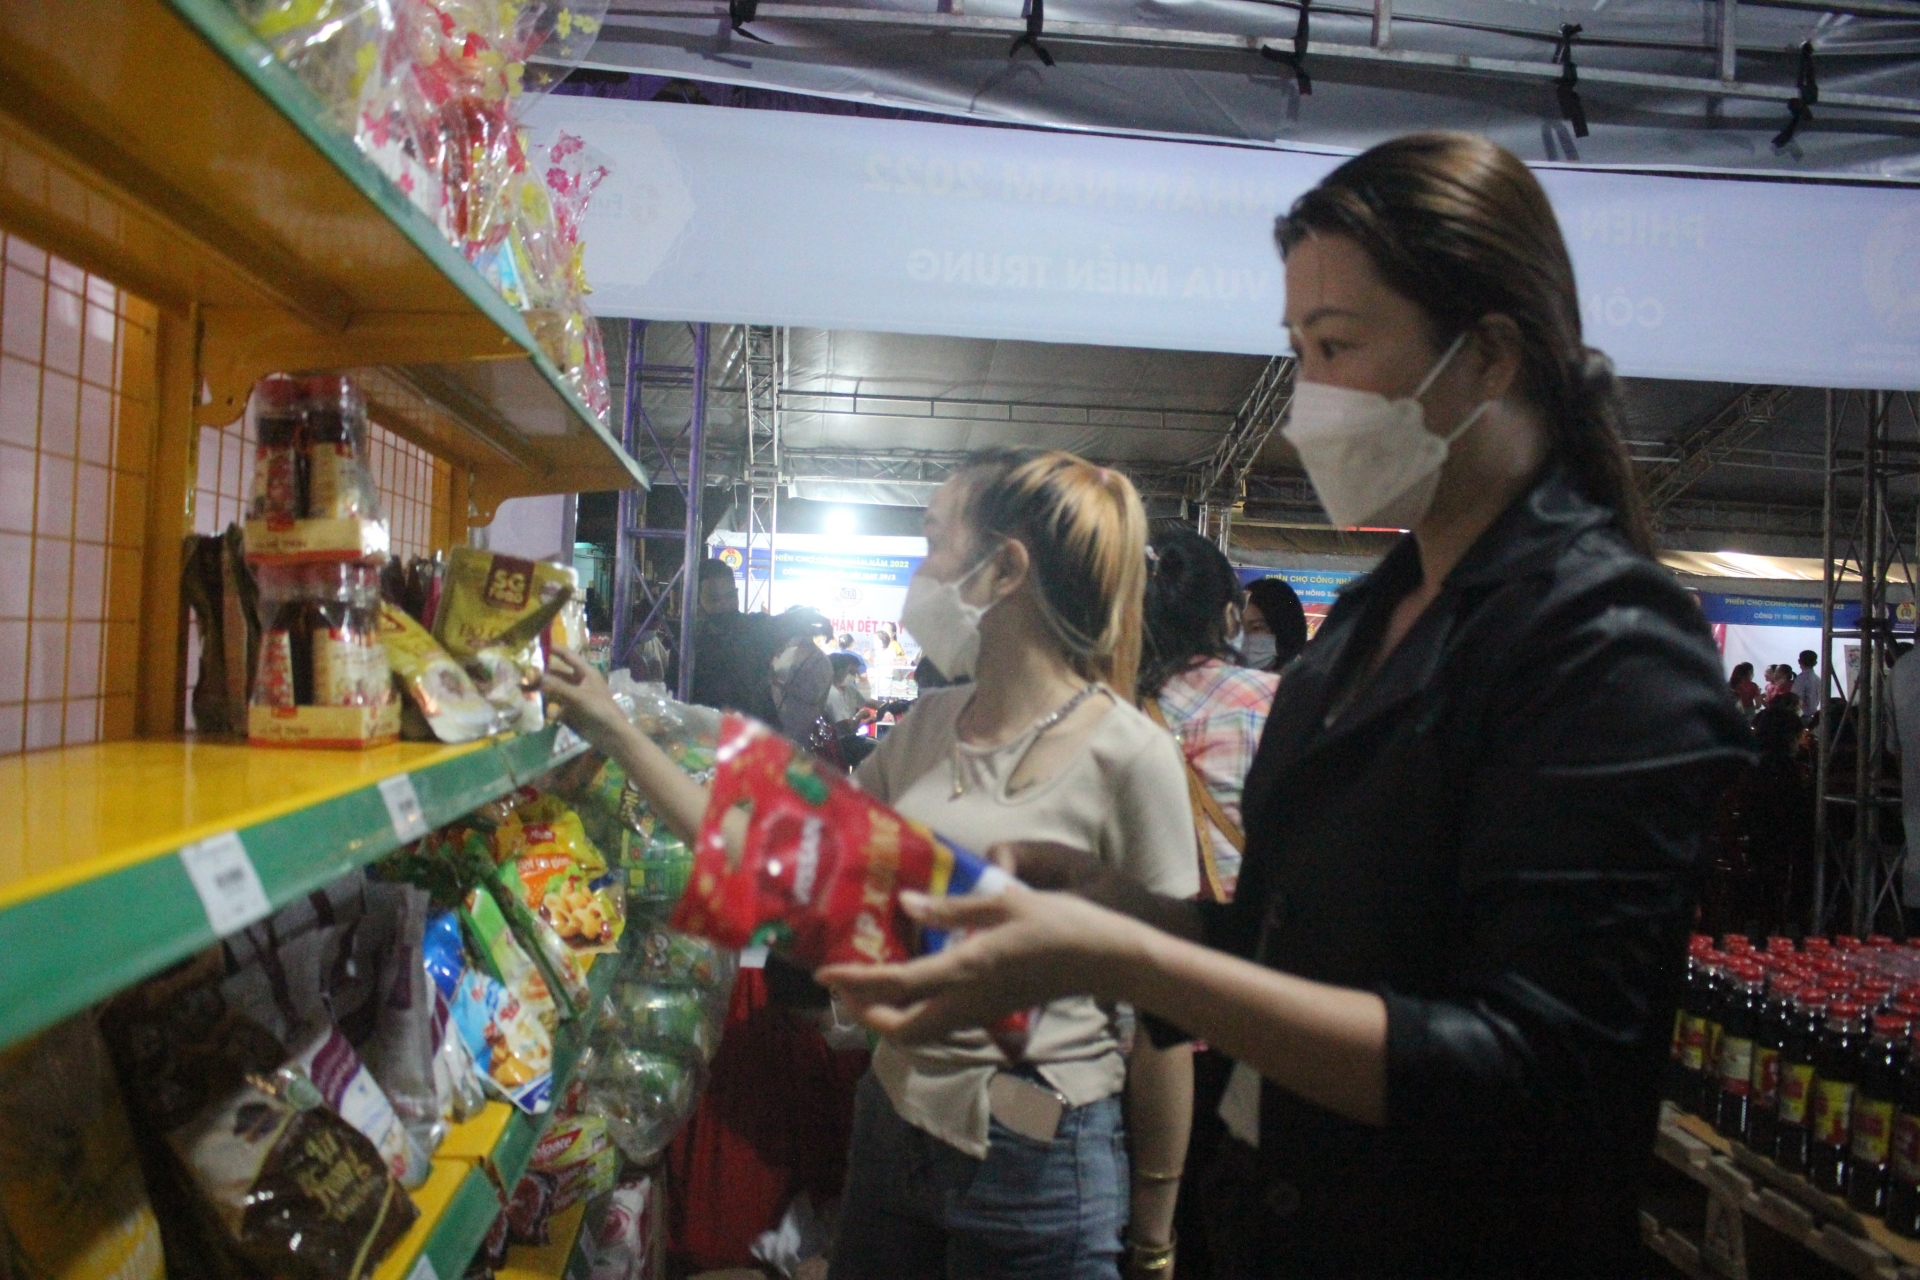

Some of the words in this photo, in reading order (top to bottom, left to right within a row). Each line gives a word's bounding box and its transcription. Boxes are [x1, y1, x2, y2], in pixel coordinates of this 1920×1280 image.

[775, 554, 793, 563] HIÊN
[890, 560, 909, 568] 2022
[494, 568, 526, 589] SG
[1290, 575, 1308, 584] CHỢ
[1310, 575, 1335, 584] CÔNG
[1305, 588, 1326, 597] NÔNG
[831, 611, 854, 632] HẦN
[857, 616, 878, 637] DỆT
